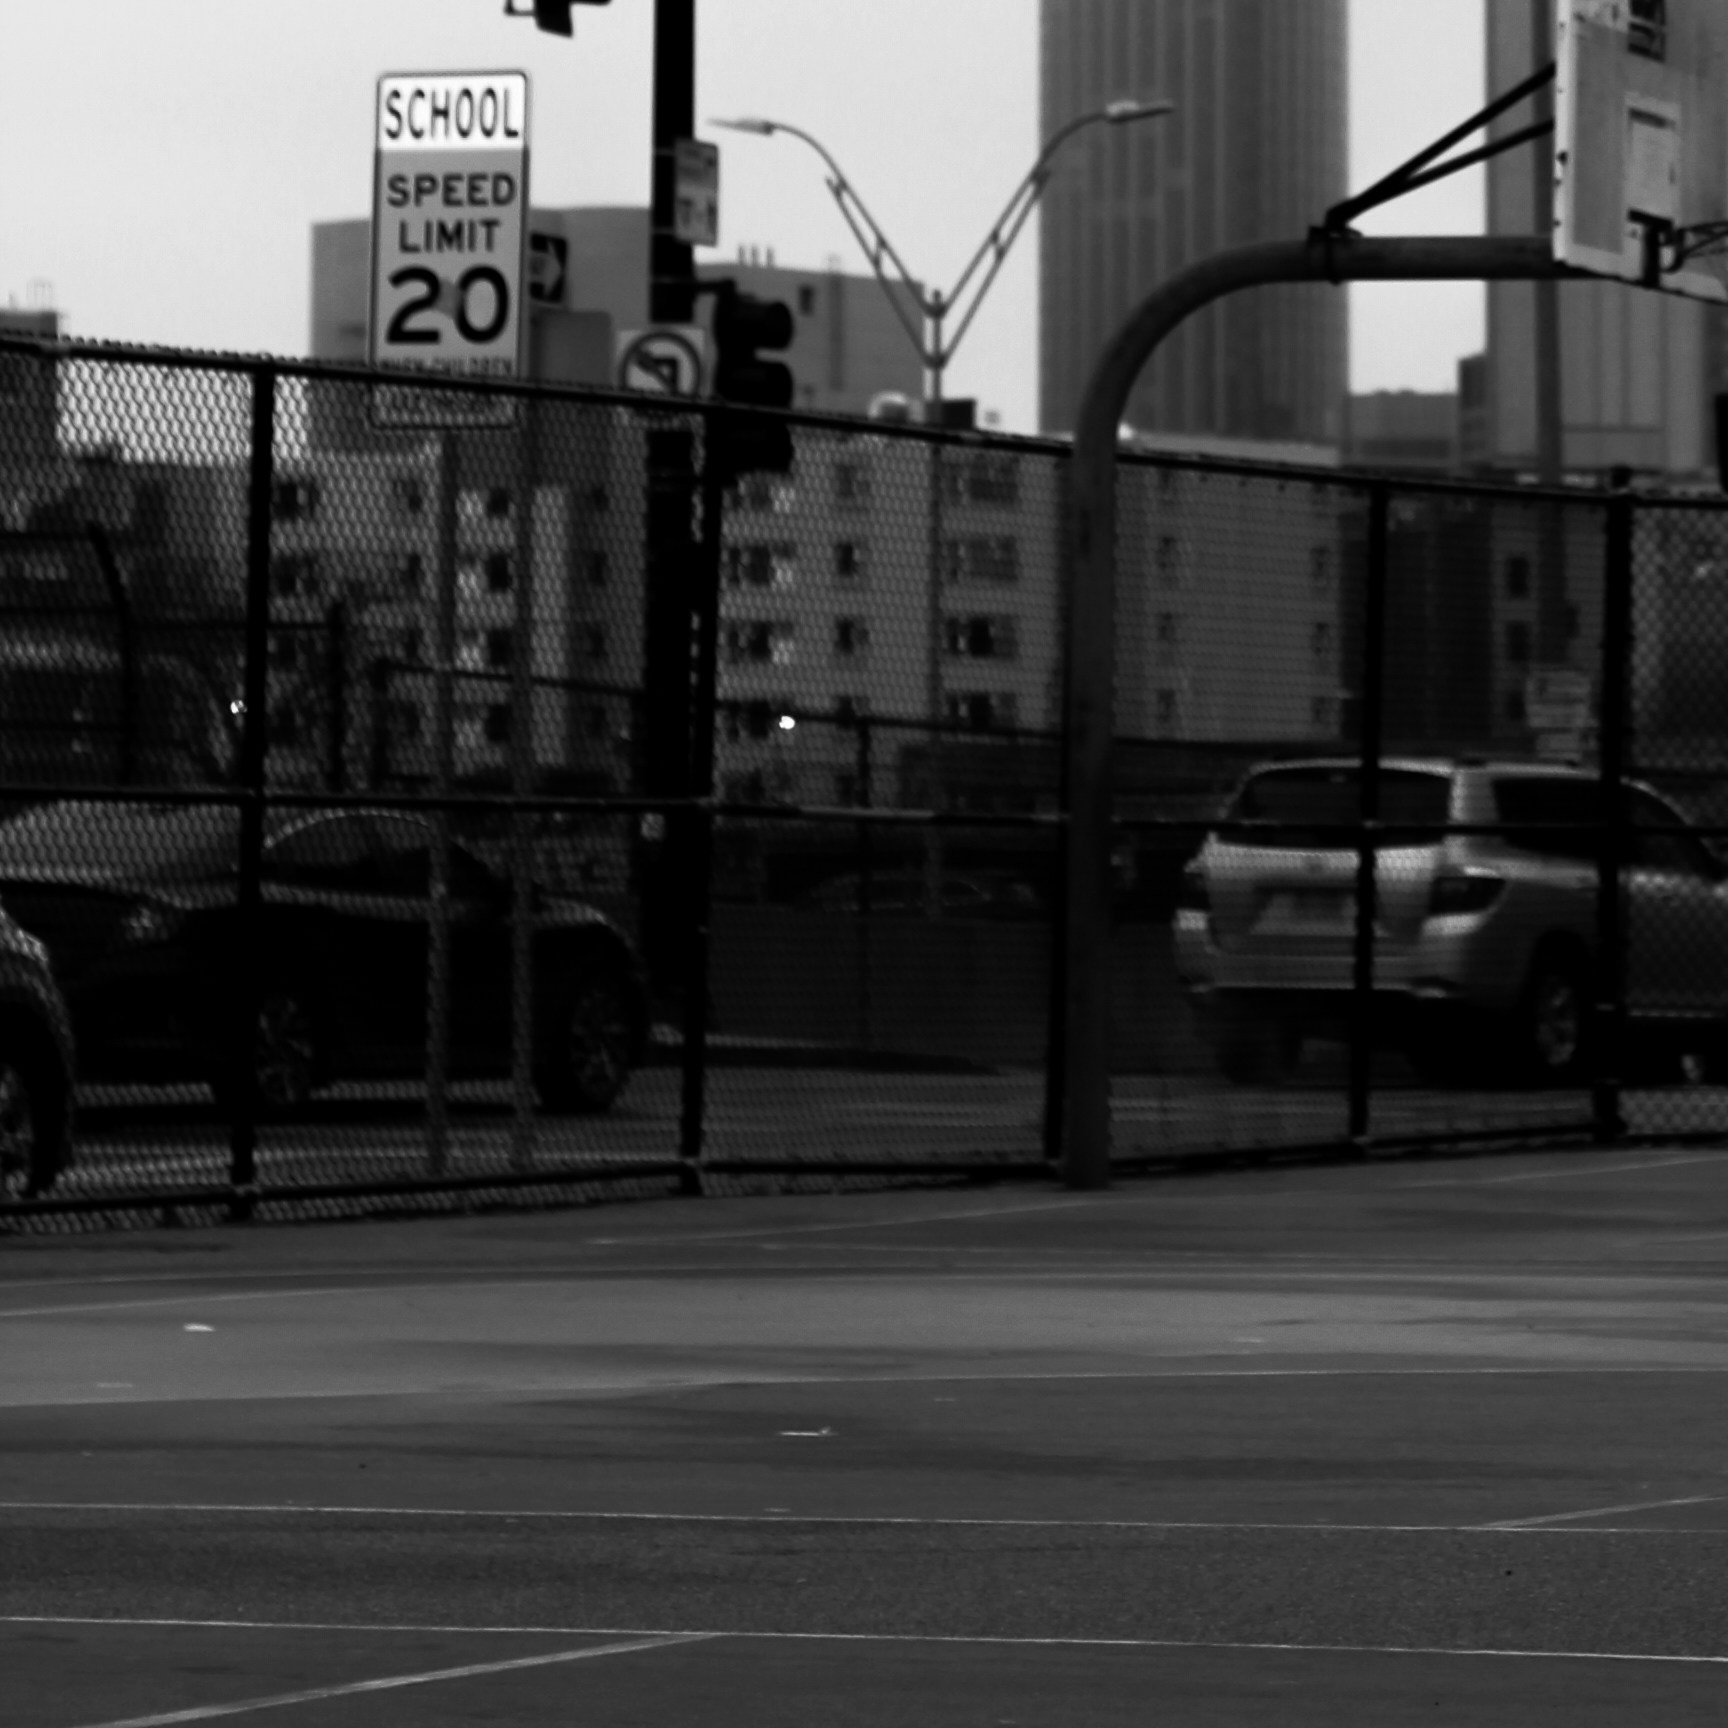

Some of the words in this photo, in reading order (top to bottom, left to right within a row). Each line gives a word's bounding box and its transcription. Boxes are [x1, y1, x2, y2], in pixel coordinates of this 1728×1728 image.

[384, 87, 519, 140] SCHOOL
[386, 172, 516, 209] SPEED
[399, 218, 501, 254] LIMIT
[386, 265, 510, 345] 20
